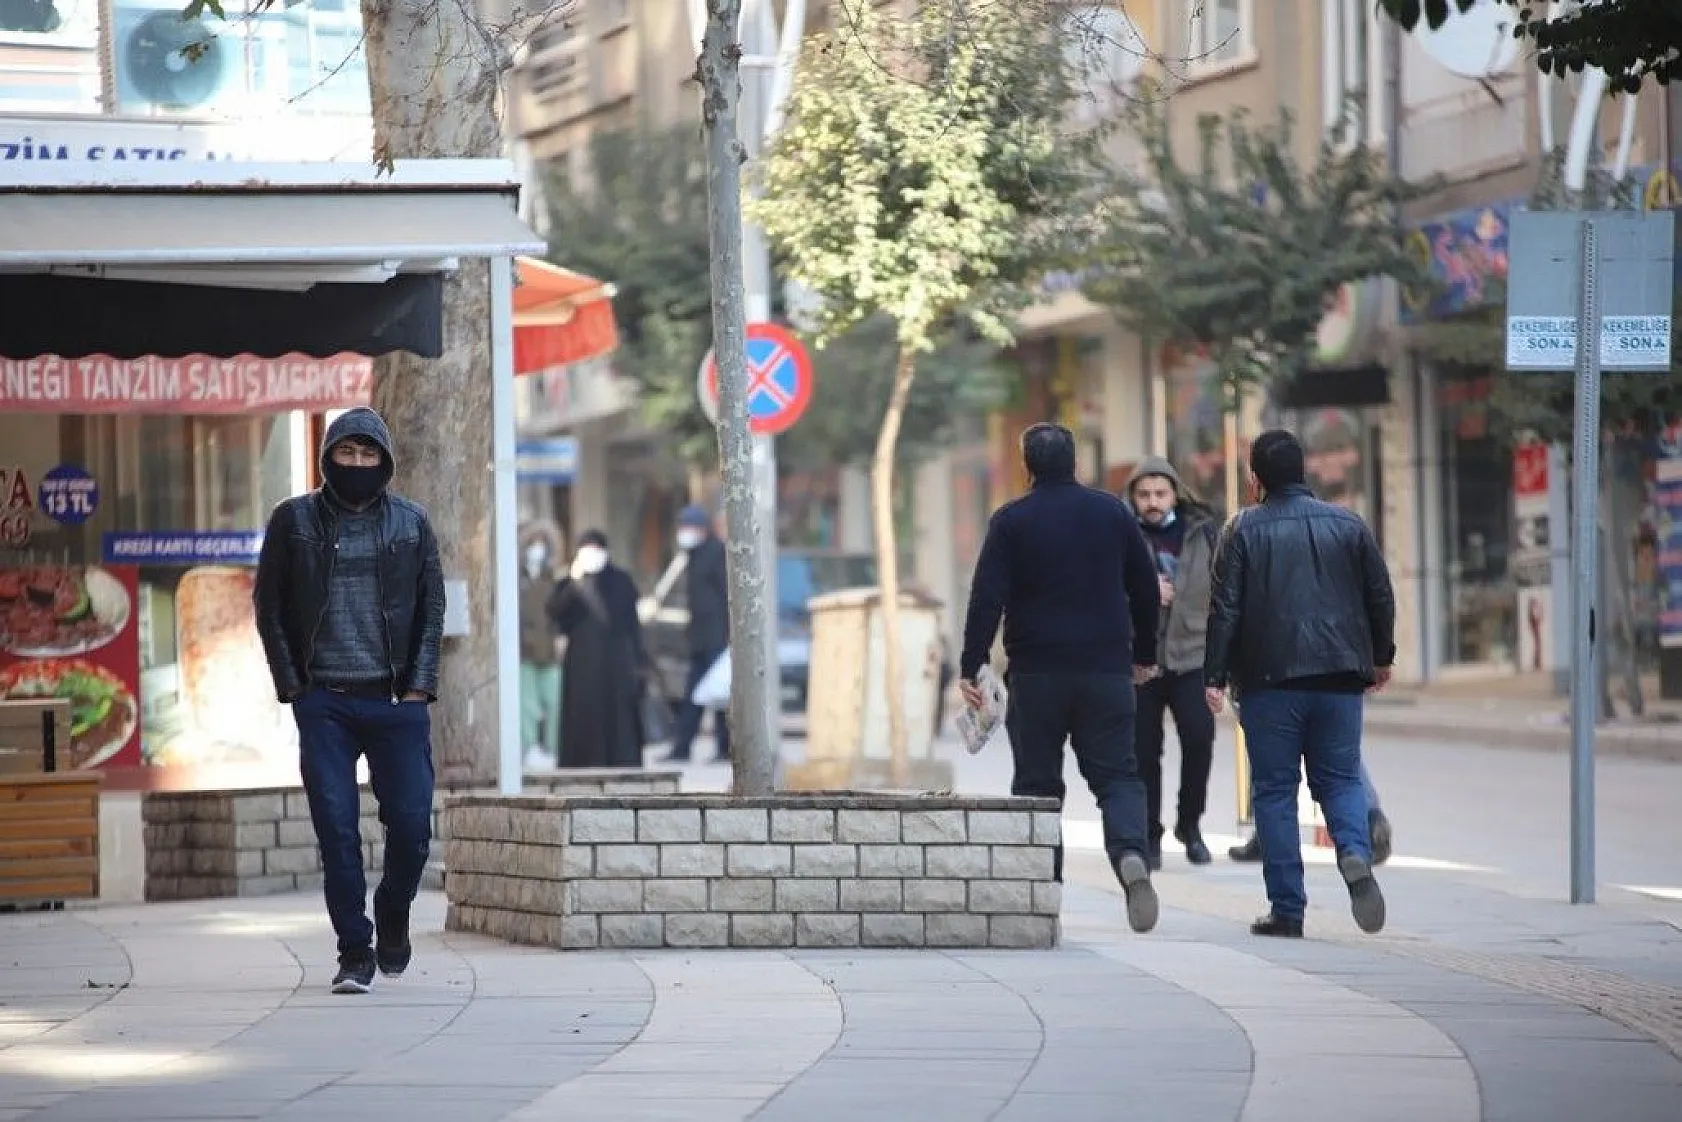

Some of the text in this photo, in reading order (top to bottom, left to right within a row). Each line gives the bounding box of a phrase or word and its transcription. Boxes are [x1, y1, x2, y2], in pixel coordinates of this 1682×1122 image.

[78, 355, 181, 400] TANZİM
[189, 360, 262, 406] SATIŞ
[46, 492, 93, 514] 13 TL
